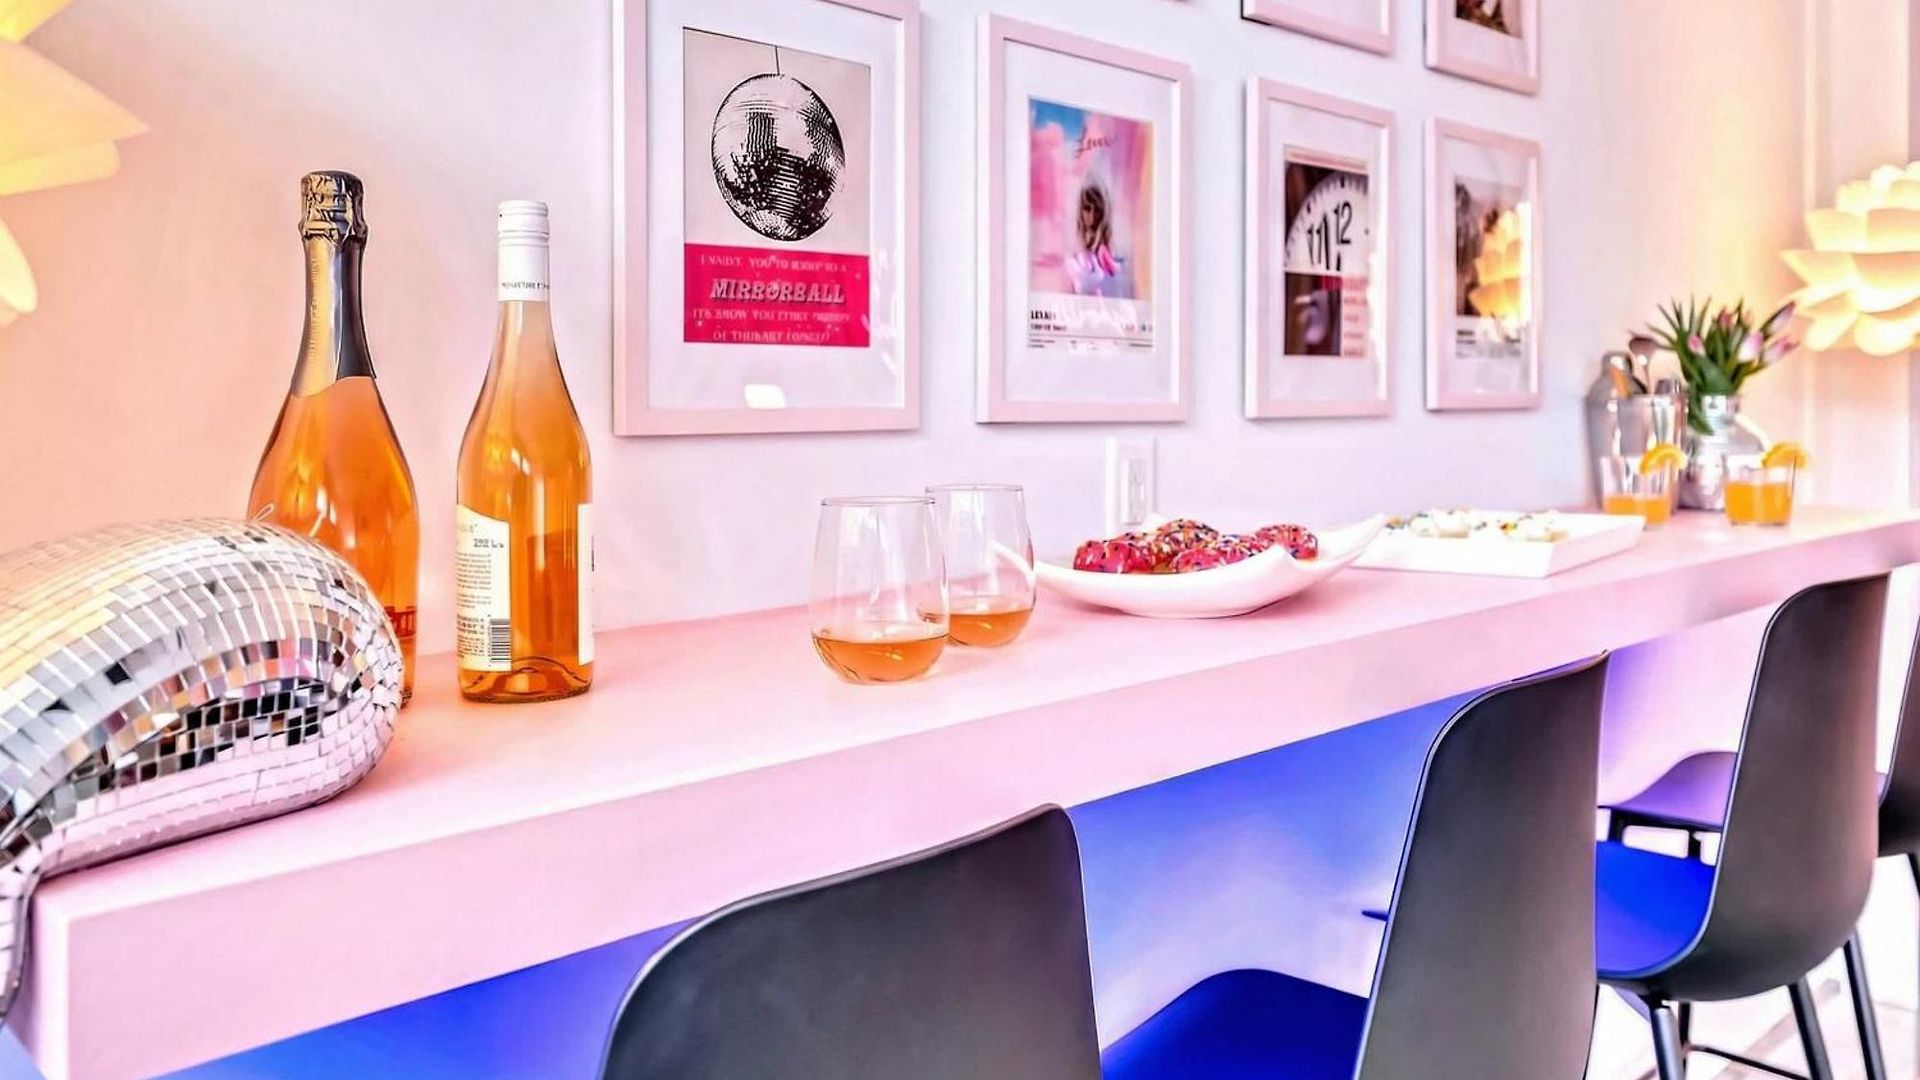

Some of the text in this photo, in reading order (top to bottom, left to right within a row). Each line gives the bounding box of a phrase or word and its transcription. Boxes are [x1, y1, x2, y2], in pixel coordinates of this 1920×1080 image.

[1334, 201, 1352, 244] 12
[710, 278, 845, 304] MIRRORBALL
[715, 309, 747, 321] SHOW
[752, 309, 775, 321] YOU
